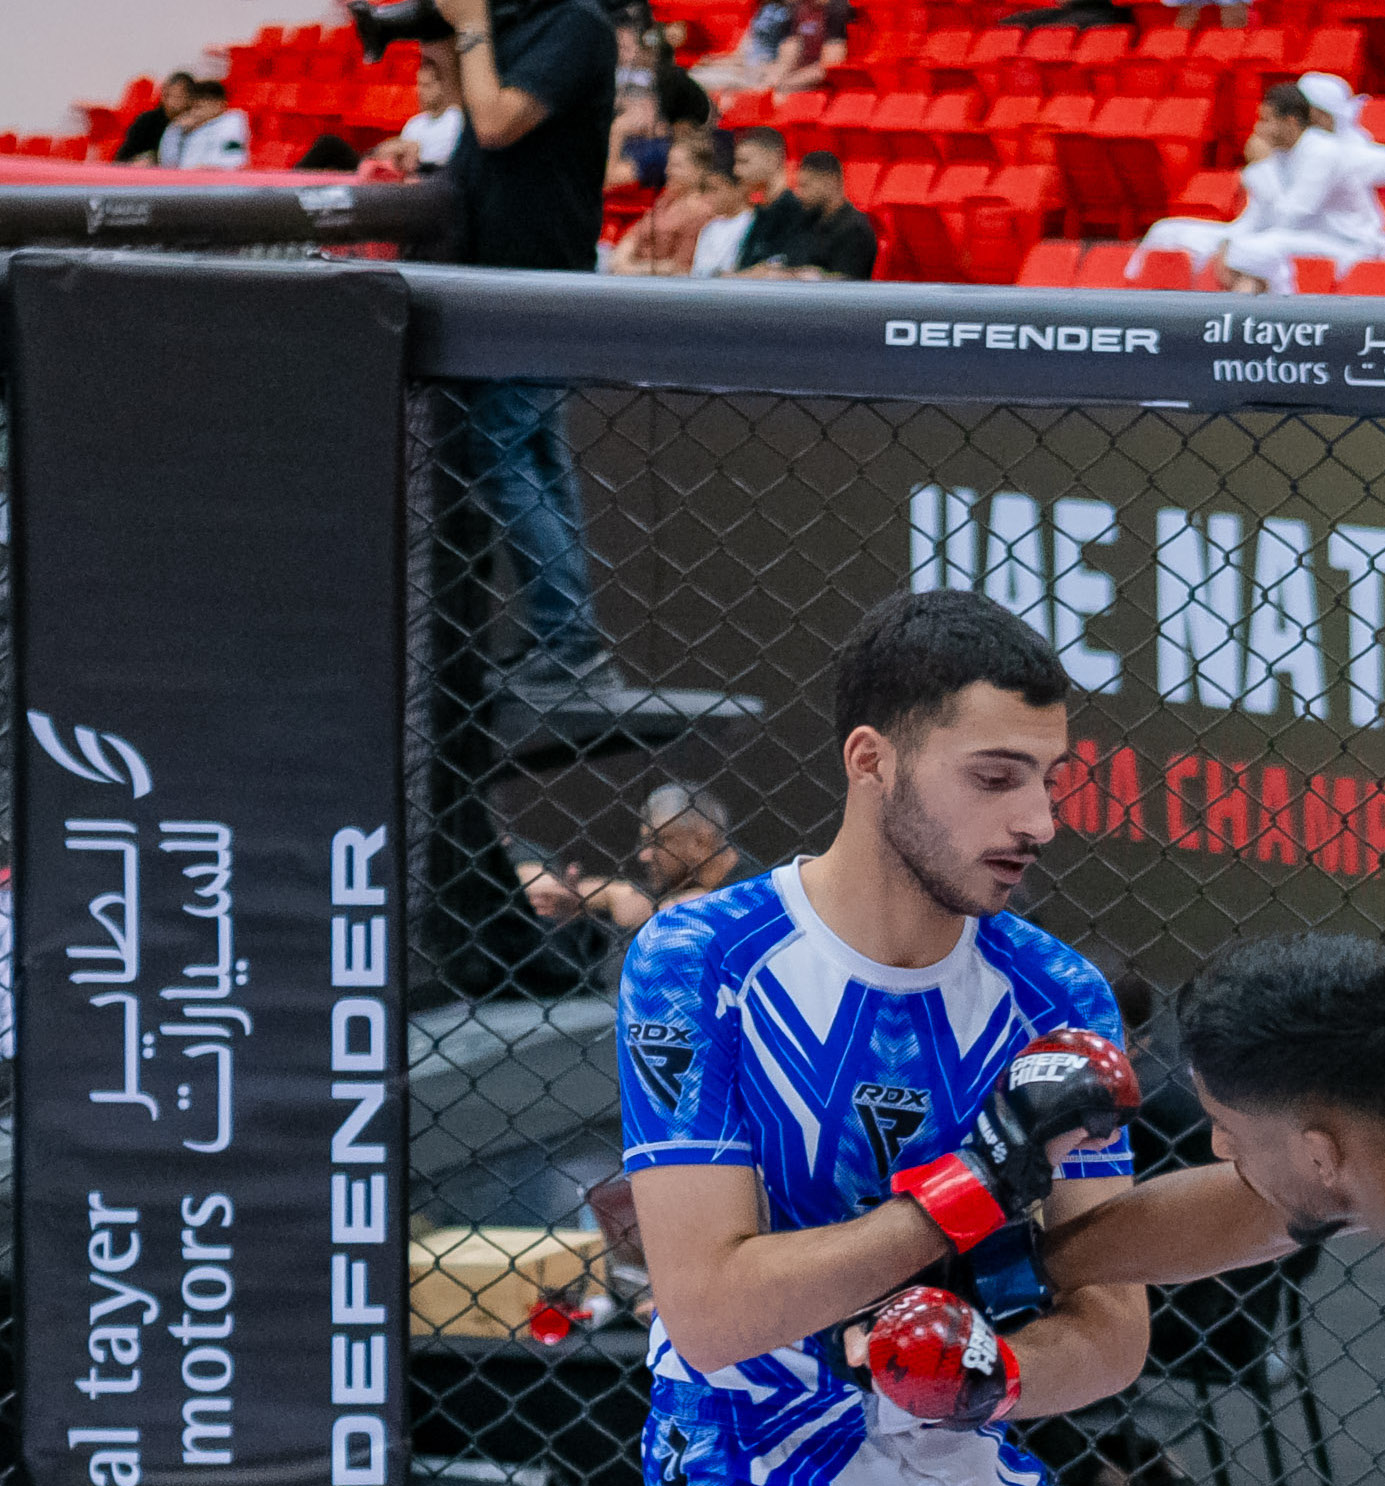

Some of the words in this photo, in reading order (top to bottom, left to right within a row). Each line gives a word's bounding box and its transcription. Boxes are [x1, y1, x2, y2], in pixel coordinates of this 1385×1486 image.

[885, 319, 1161, 355] DEFENDER
[1203, 314, 1229, 345] al
[1241, 316, 1330, 353] tayer
[1212, 356, 1331, 386] motors
[1050, 738, 1145, 843] MA
[159, 820, 252, 1154] للسيارات
[627, 1022, 695, 1045] RDX
[854, 1082, 931, 1108] RDX
[1009, 1064, 1065, 1092] HILL
[75, 1190, 160, 1399] tayer
[170, 1191, 234, 1466] motors
